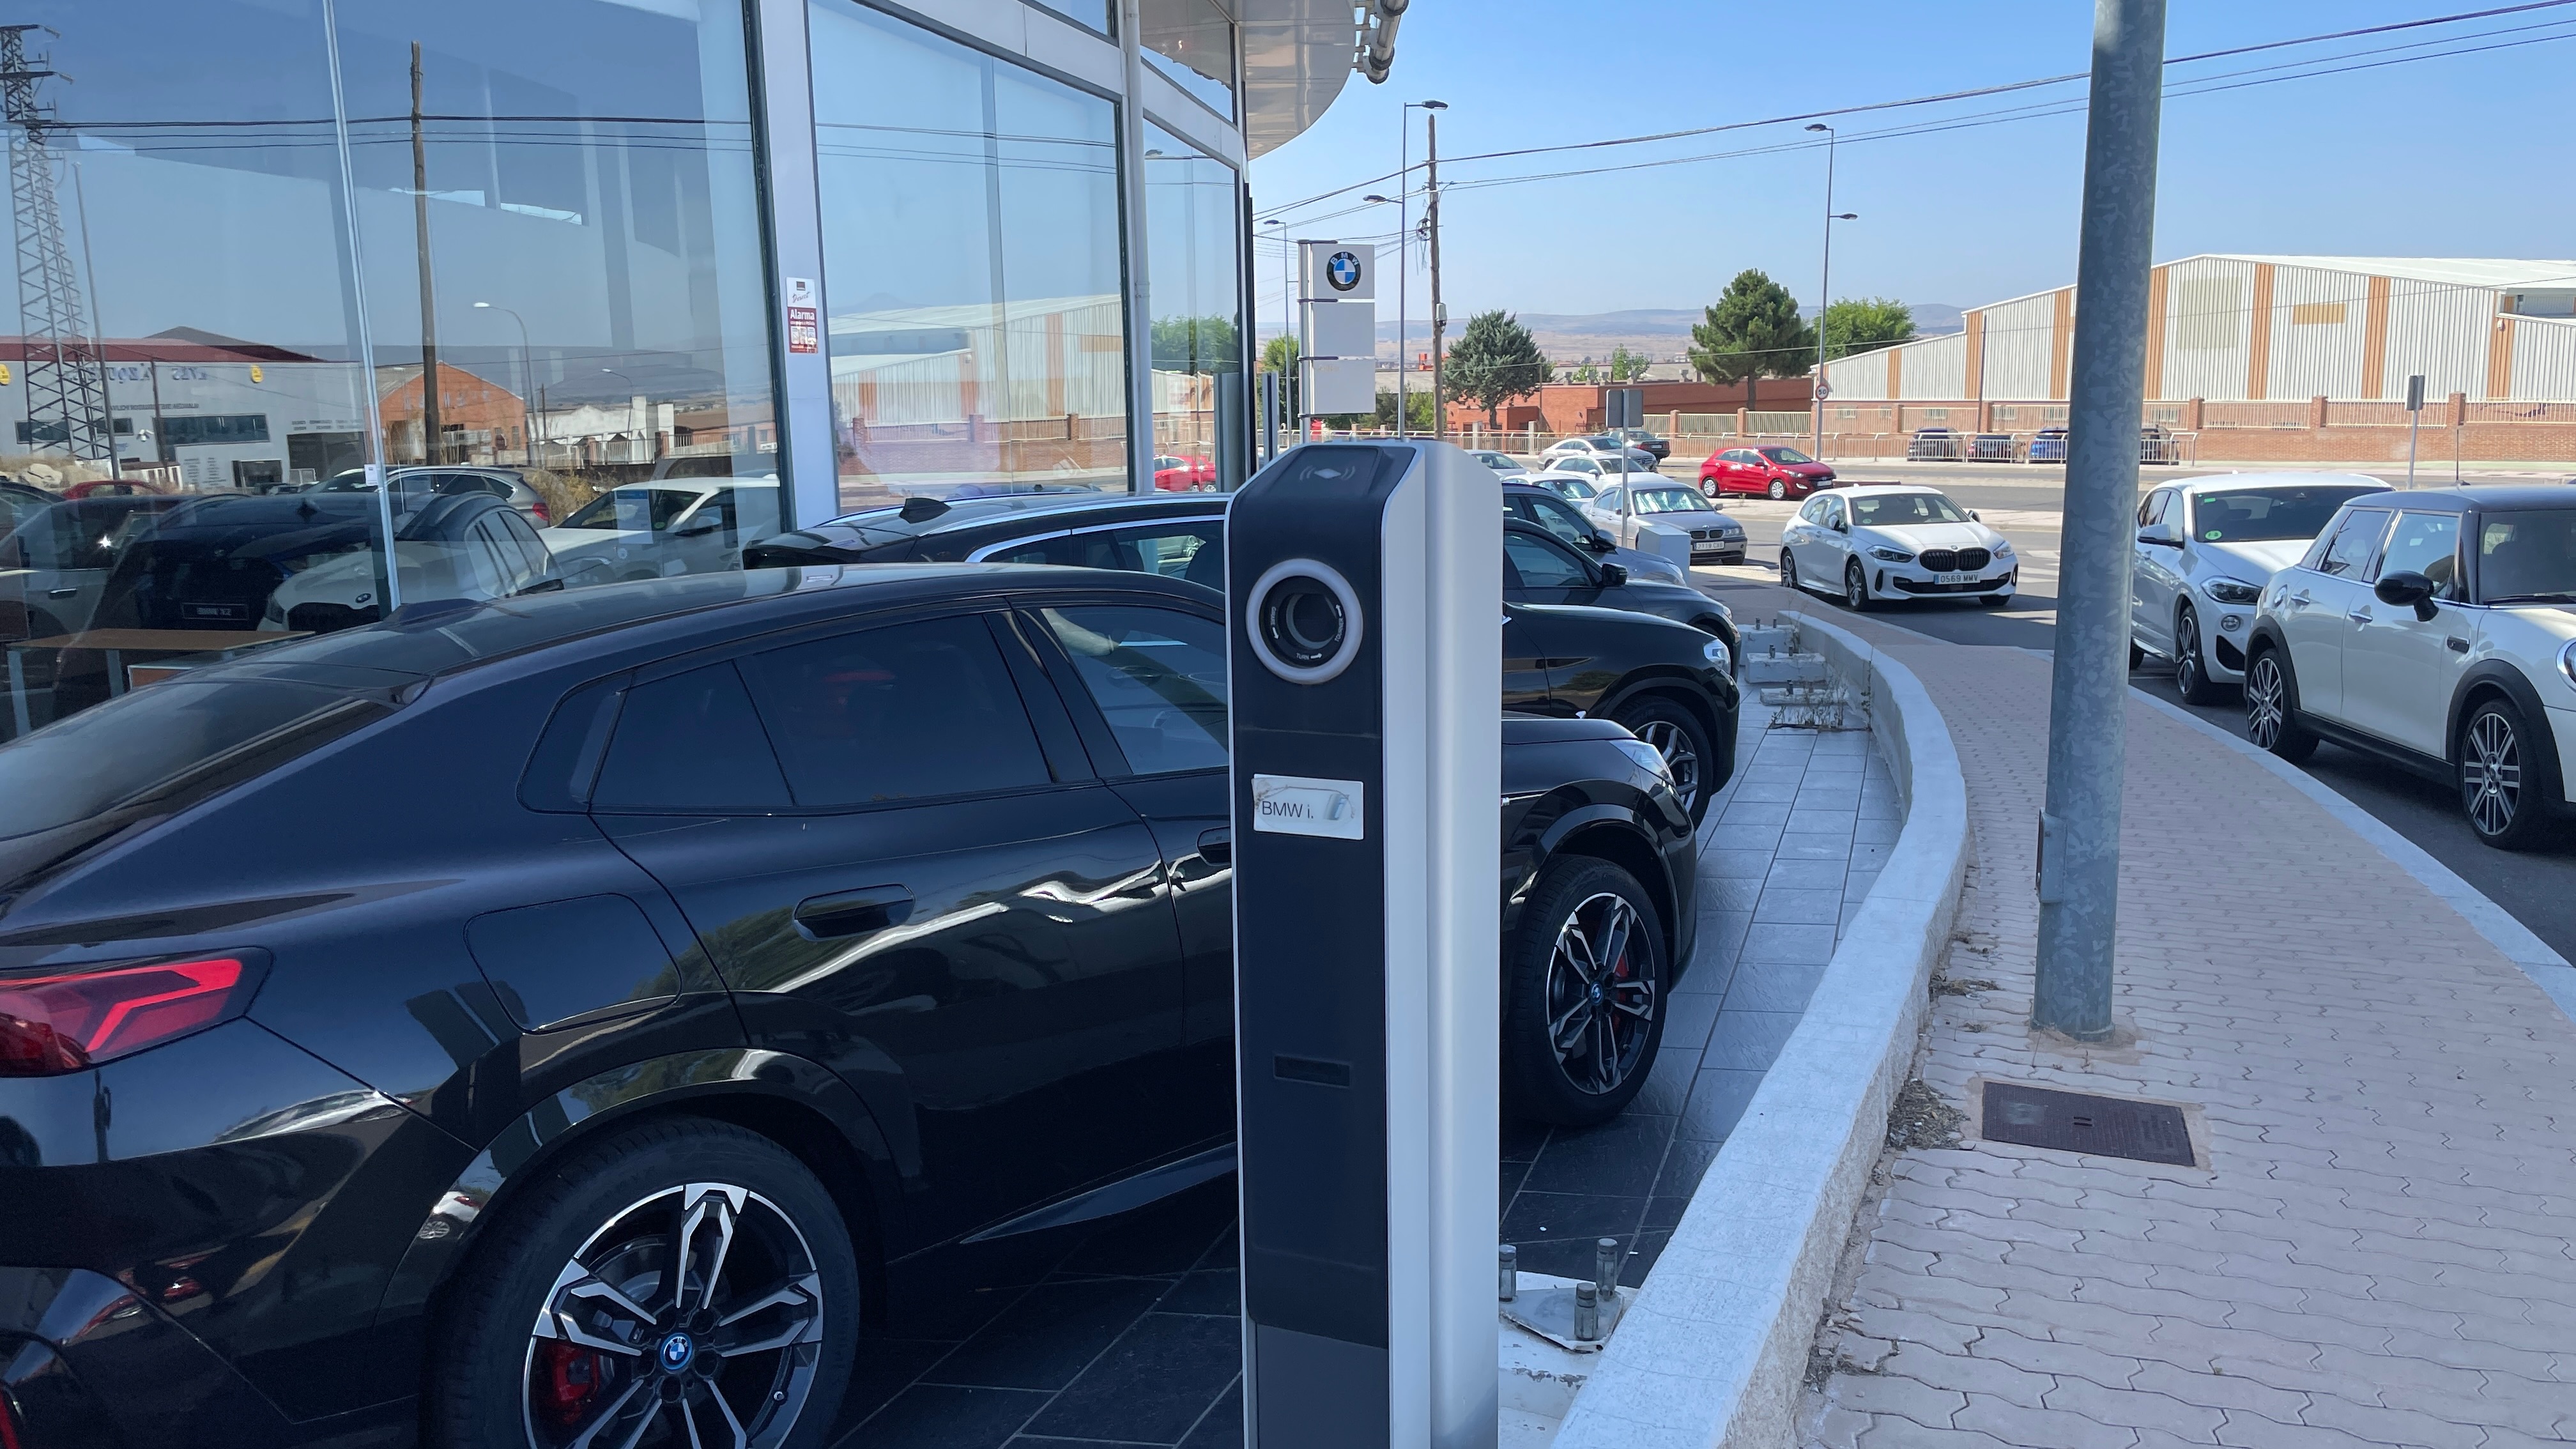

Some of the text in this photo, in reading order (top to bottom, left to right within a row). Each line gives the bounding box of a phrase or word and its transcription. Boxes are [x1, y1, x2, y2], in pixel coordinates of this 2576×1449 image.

[790, 309, 815, 320] Alarma
[1296, 652, 1310, 661] TURN
[1262, 801, 1303, 818] BMW
